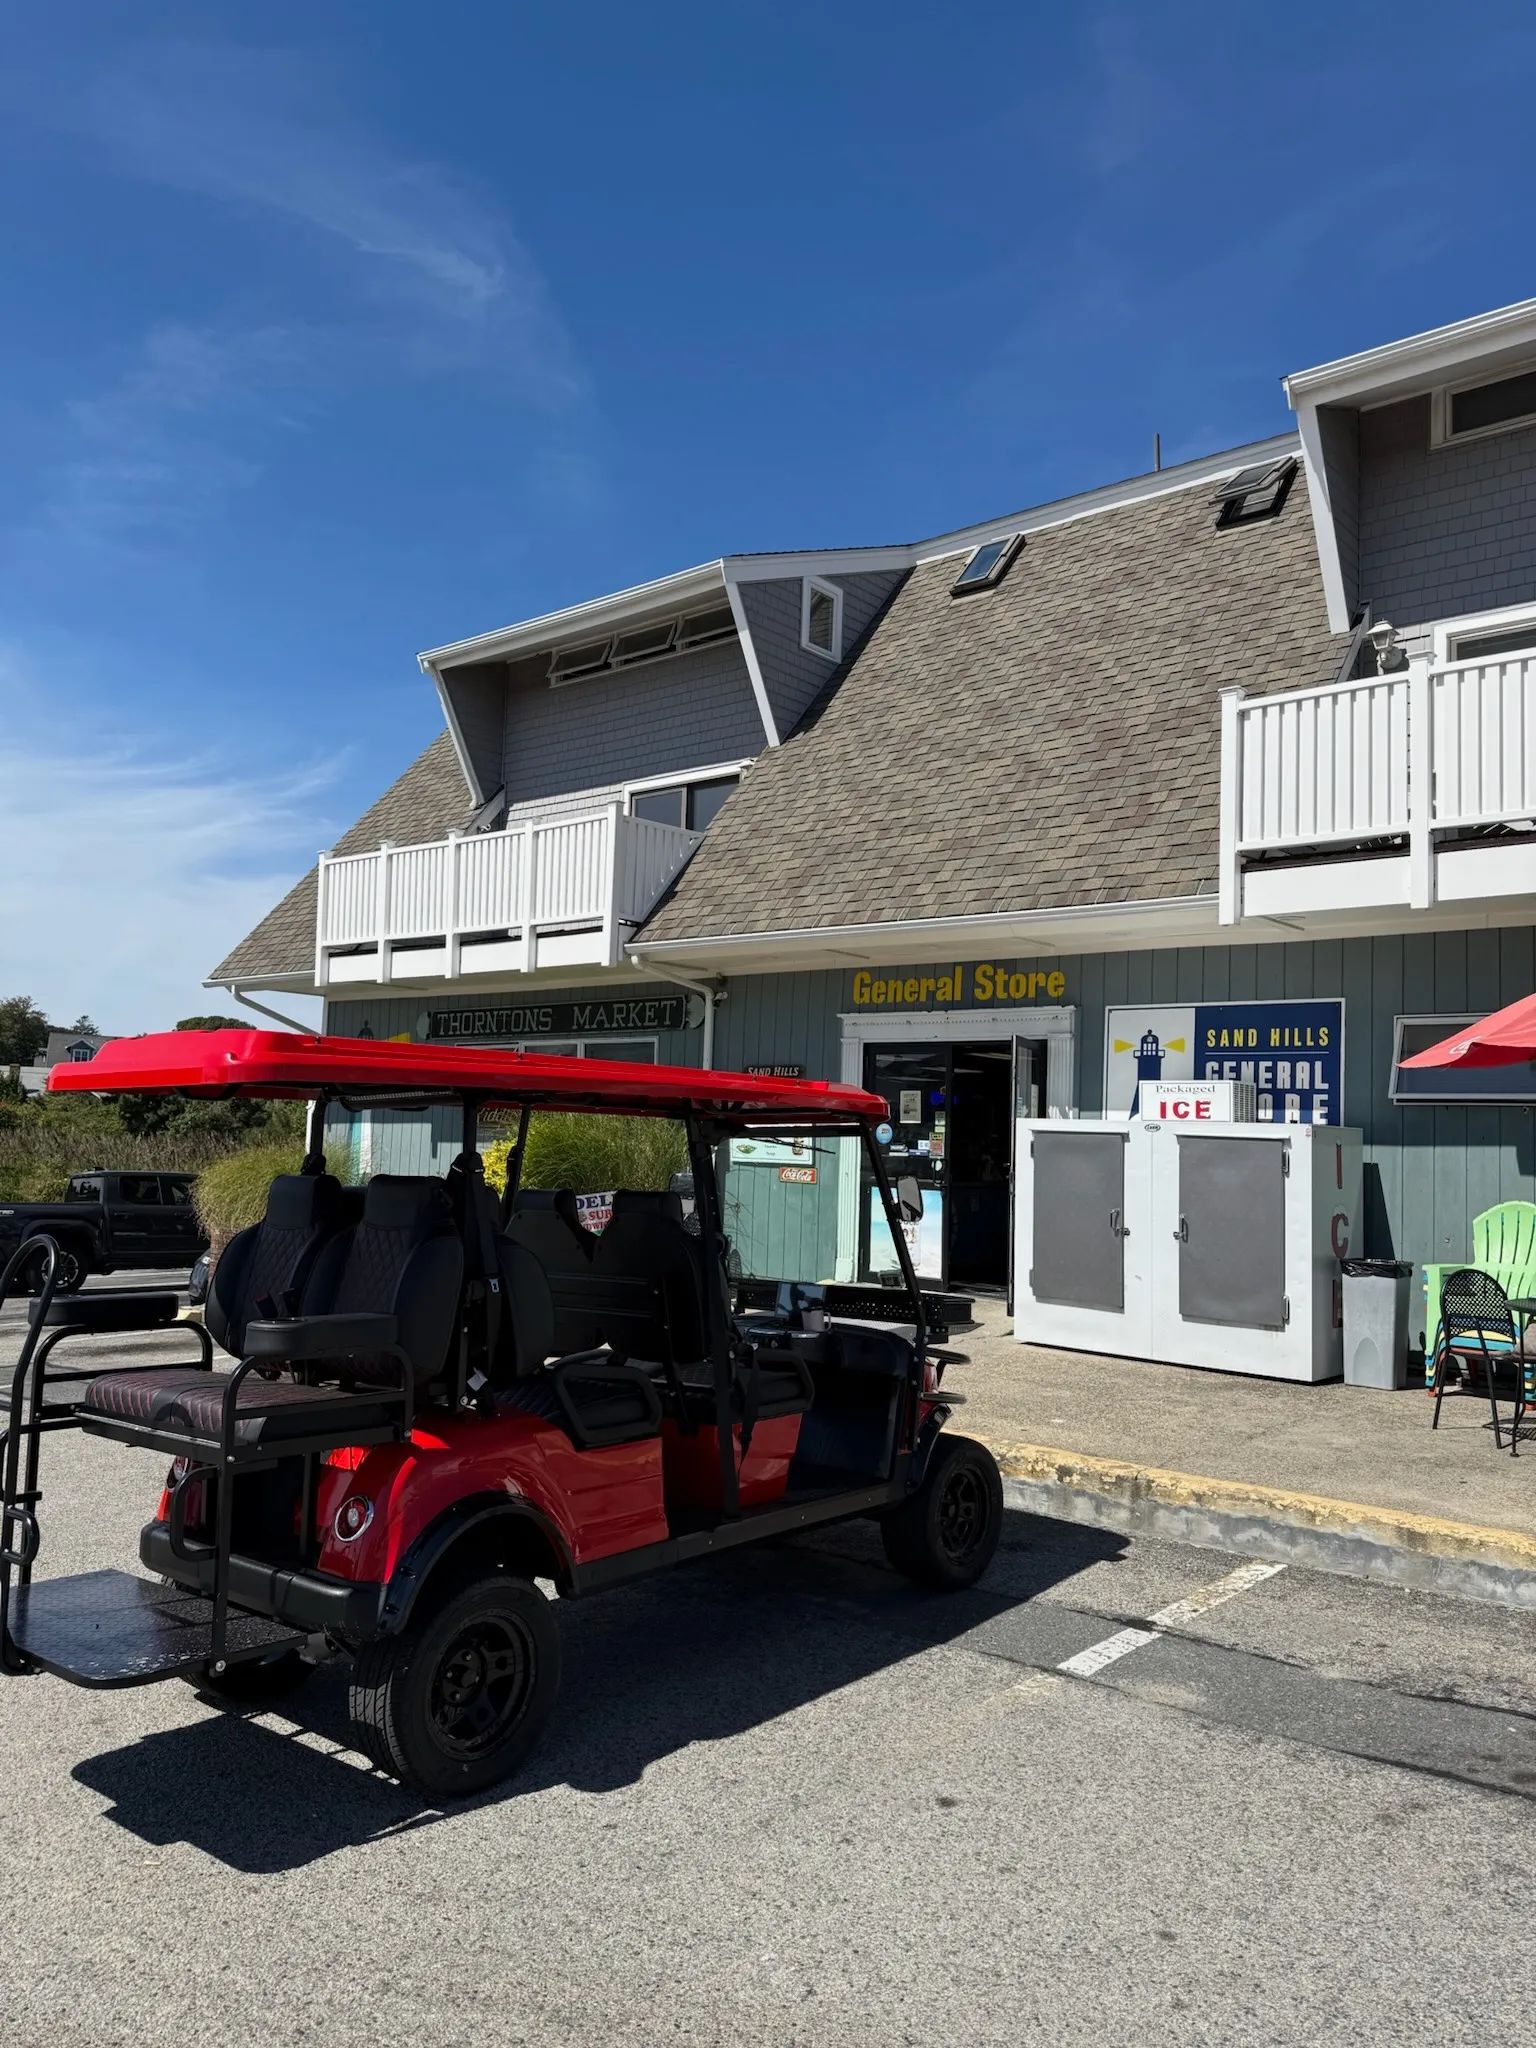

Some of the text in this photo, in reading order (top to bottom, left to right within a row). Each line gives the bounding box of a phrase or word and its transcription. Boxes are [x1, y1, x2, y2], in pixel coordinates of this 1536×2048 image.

[853, 964, 1066, 1004] General Store
[437, 1000, 678, 1035] THORNTONS MARKET
[1207, 1027, 1330, 1048] SAND HILLS
[747, 1066, 800, 1077] SAND HILLS
[1205, 1061, 1330, 1090] GENERAL
[1155, 1085, 1216, 1095] Packaged
[1159, 1100, 1212, 1120] ICE
[1257, 1093, 1330, 1125] ORE
